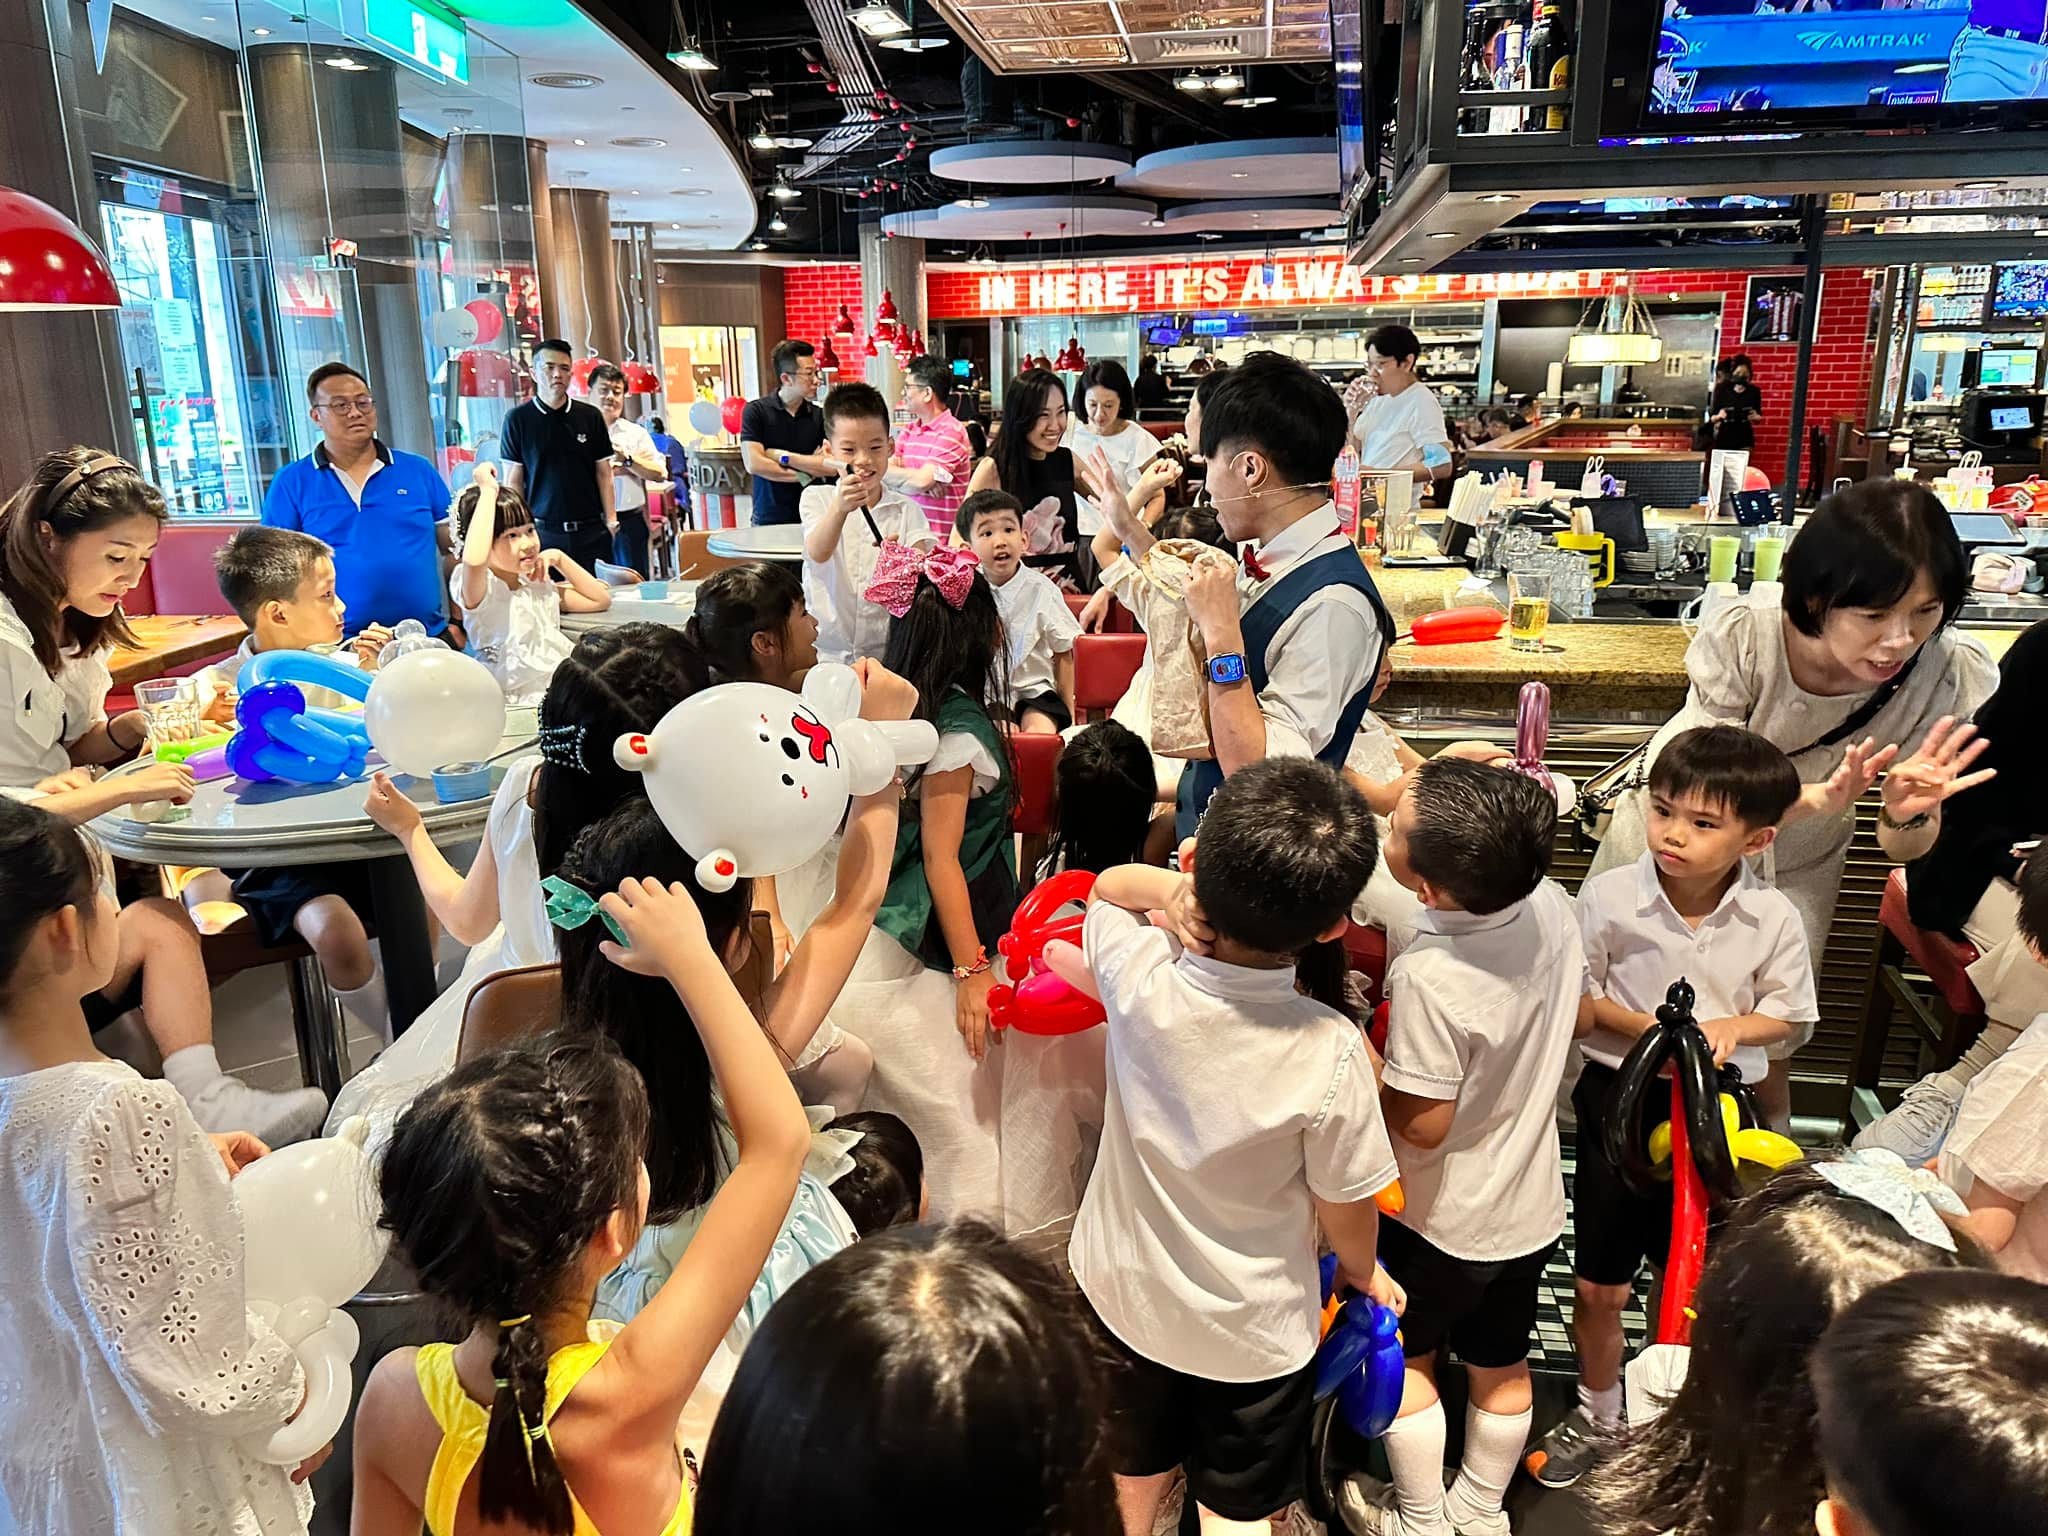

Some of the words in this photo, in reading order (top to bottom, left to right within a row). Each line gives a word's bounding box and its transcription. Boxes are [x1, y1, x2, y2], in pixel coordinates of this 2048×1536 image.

[1829, 32, 1928, 49] AMTRAK
[979, 275, 1016, 310] IN
[1029, 271, 1139, 312] HERE,
[1153, 266, 1229, 304] IT'S
